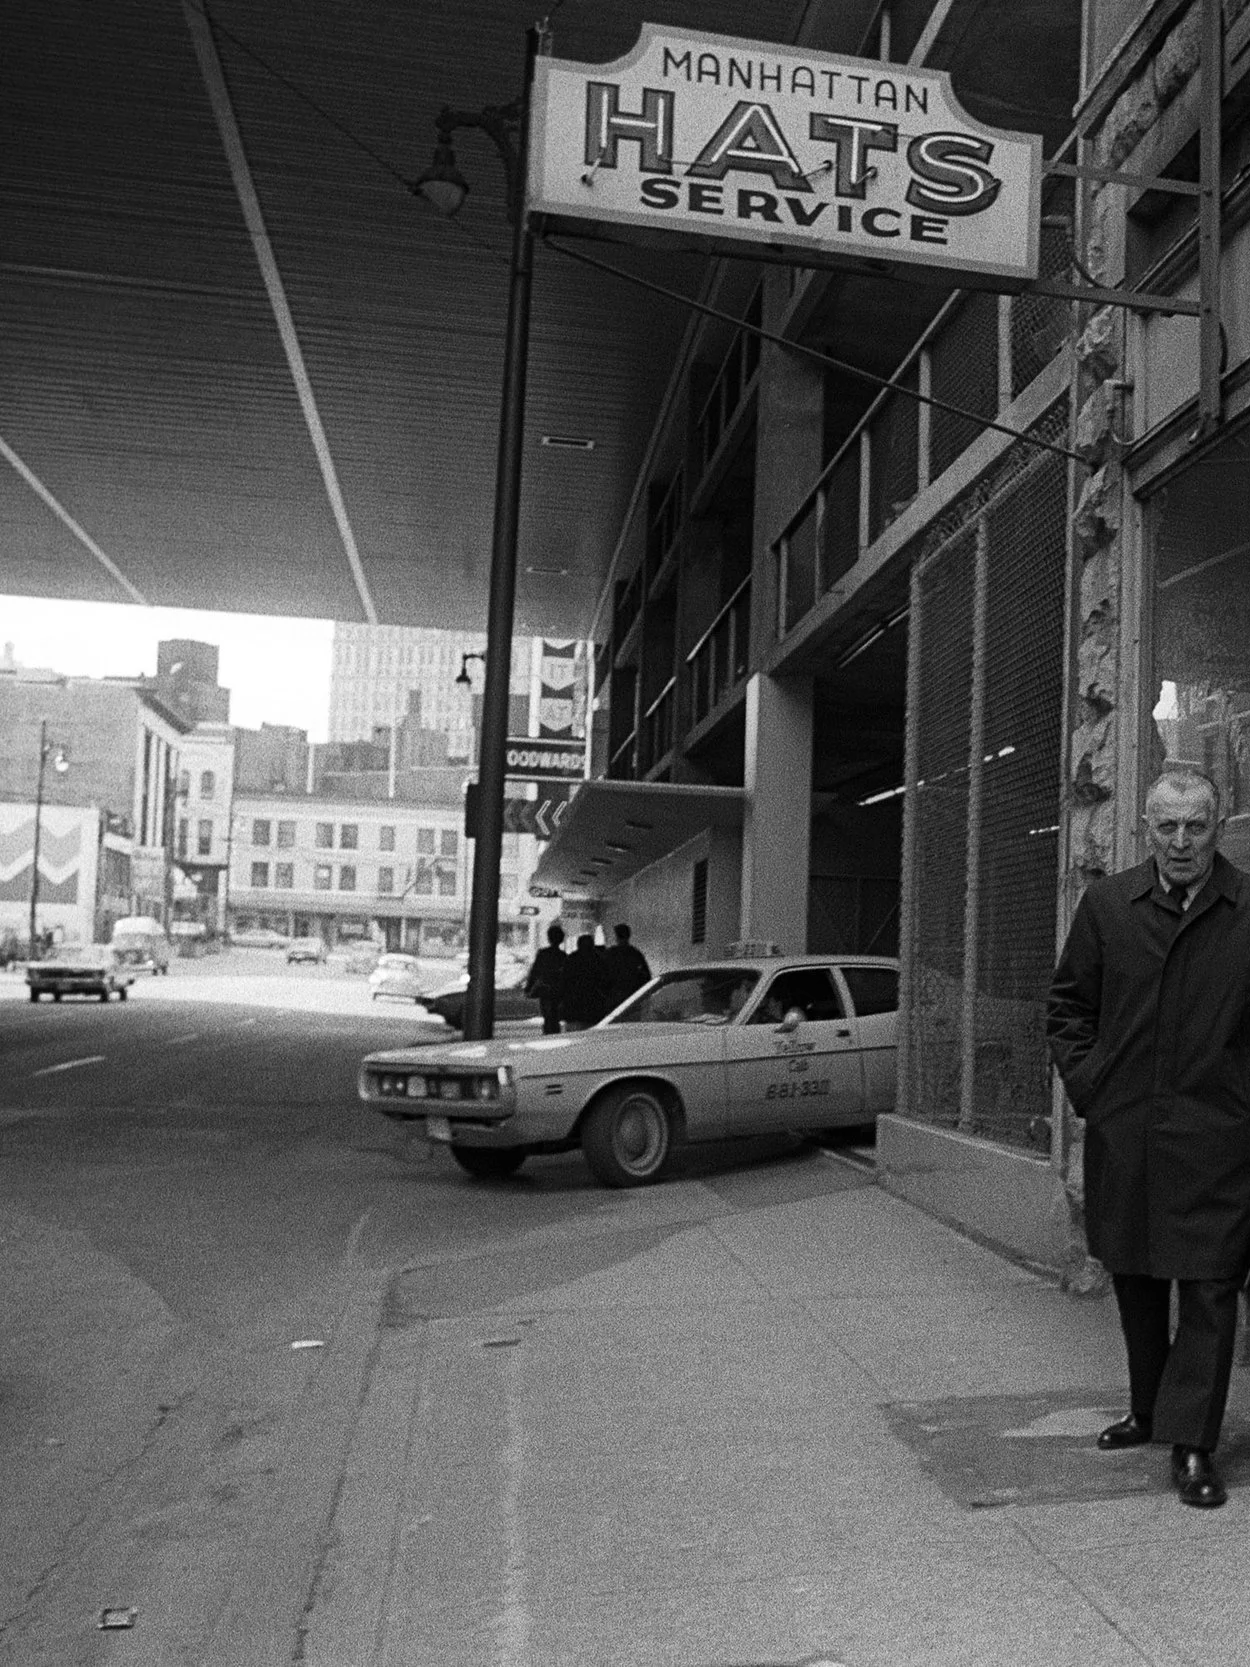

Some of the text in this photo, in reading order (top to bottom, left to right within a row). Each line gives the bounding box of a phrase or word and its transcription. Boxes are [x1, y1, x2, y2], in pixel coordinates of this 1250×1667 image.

[661, 45, 929, 116] MANHATTAN
[584, 80, 1003, 218] HATS
[639, 176, 950, 247] SERVICE
